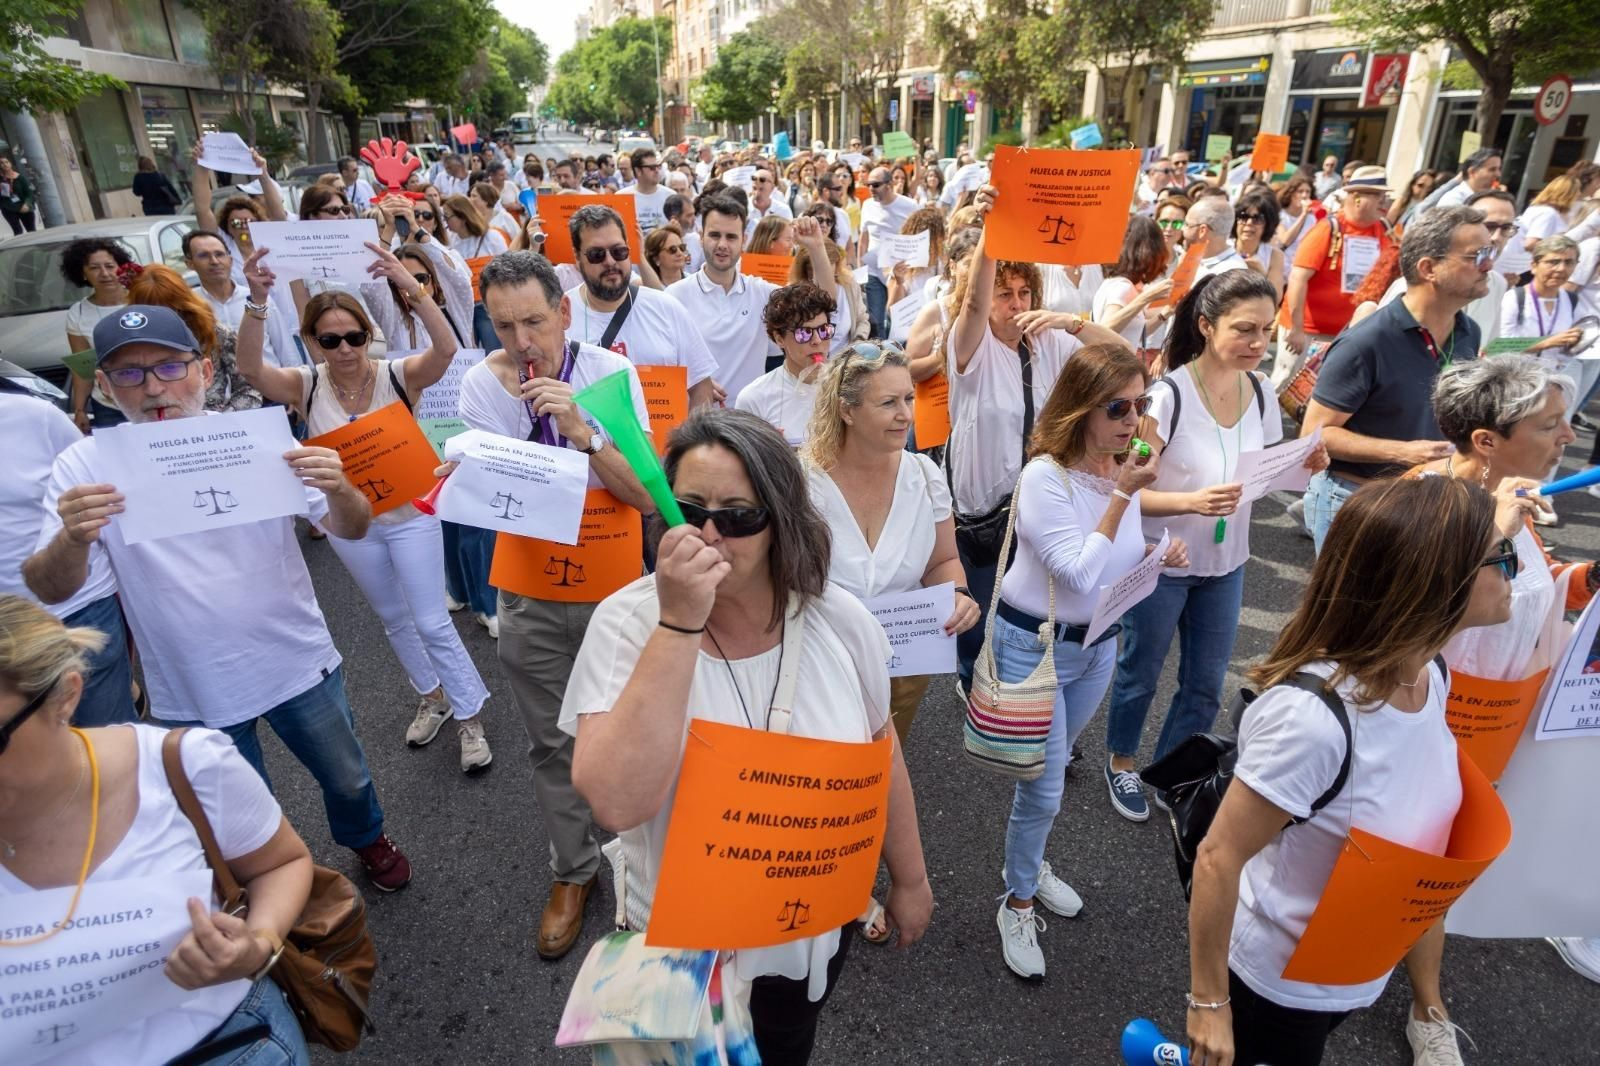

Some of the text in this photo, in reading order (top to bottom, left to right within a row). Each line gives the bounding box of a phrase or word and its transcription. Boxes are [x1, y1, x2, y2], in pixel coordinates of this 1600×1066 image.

[1544, 90, 1564, 108] 50
[1030, 168, 1064, 176] HUELGA
[149, 438, 188, 449] HUELGA
[208, 430, 248, 441] JUSTICIA
[341, 441, 352, 450] EN
[353, 427, 384, 445] JUSTICIA
[156, 452, 207, 462] PARALIZACION
[173, 454, 242, 468] FUNCIONES CLARAS
[480, 442, 510, 453] HUELGA
[525, 452, 555, 463] JUSTICIA
[168, 459, 251, 476] RETRIBUCIONES JUSTAS
[583, 507, 616, 515] JUSTICIA
[893, 602, 934, 612] SOCIALISTA?
[1467, 697, 1483, 705] EN
[1483, 698, 1520, 707] JUSTICIA
[1571, 704, 1584, 712] LA
[1577, 717, 1591, 725] DE
[825, 772, 882, 791] SOCIALISTA?
[722, 807, 877, 829] 44 MILLONES PARA JUECES
[705, 836, 874, 863] Y ¿NADA PARA LOS CUERPOS
[765, 863, 838, 879] GENERALES?
[52, 908, 153, 930] SOCIALISTA?
[57, 952, 101, 968] PARA
[106, 941, 161, 960] JUECES
[11, 988, 56, 1004] PARA
[62, 980, 94, 995] LOS
[99, 956, 168, 986] CUERPOS
